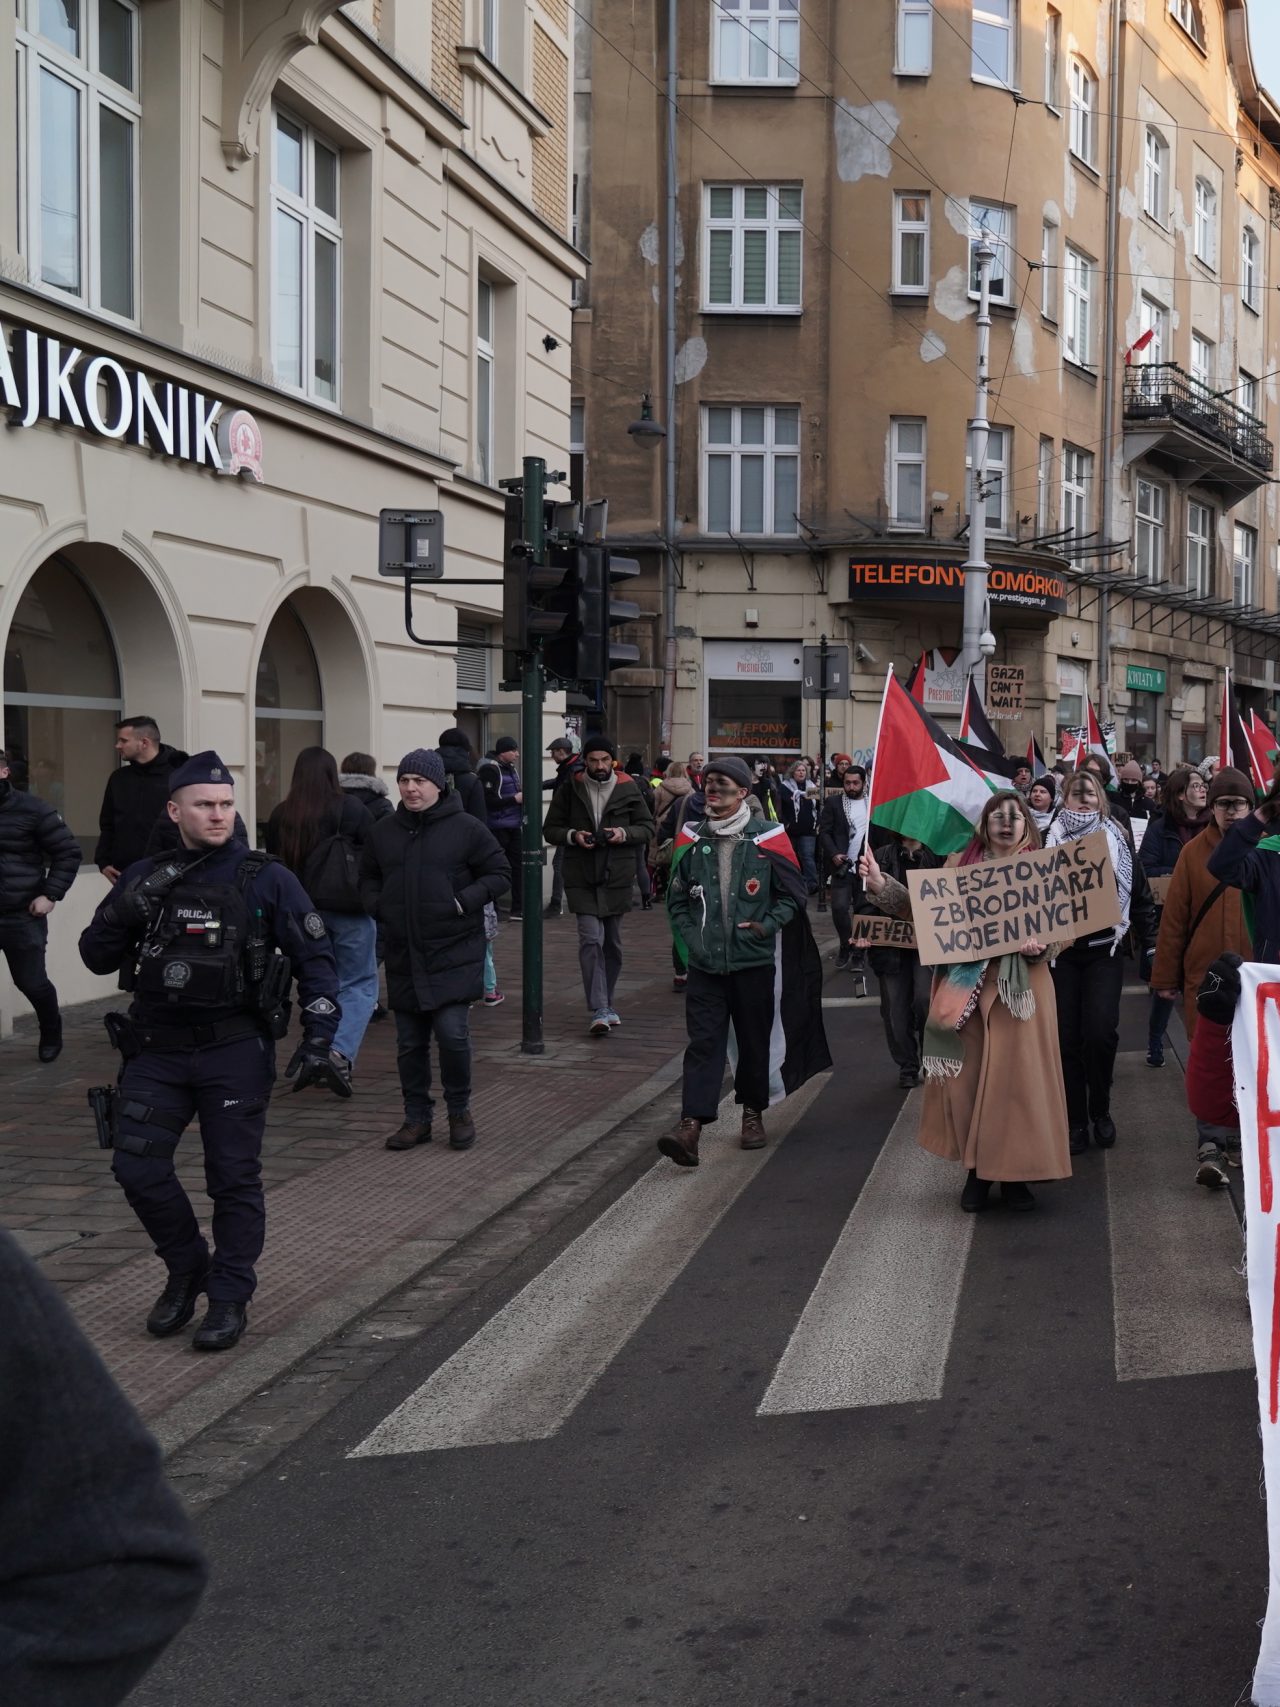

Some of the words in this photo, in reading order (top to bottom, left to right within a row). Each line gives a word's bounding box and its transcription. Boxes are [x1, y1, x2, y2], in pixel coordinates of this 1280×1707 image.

[851, 564, 965, 587] TELEFONY
[991, 667, 1024, 680] GAZA
[1127, 669, 1154, 687] KWIATY
[990, 681, 1023, 694] CAN'T
[177, 907, 213, 919] POLICJA
[853, 919, 914, 943] NEVER
[935, 896, 1088, 954] WOJENNYCH
